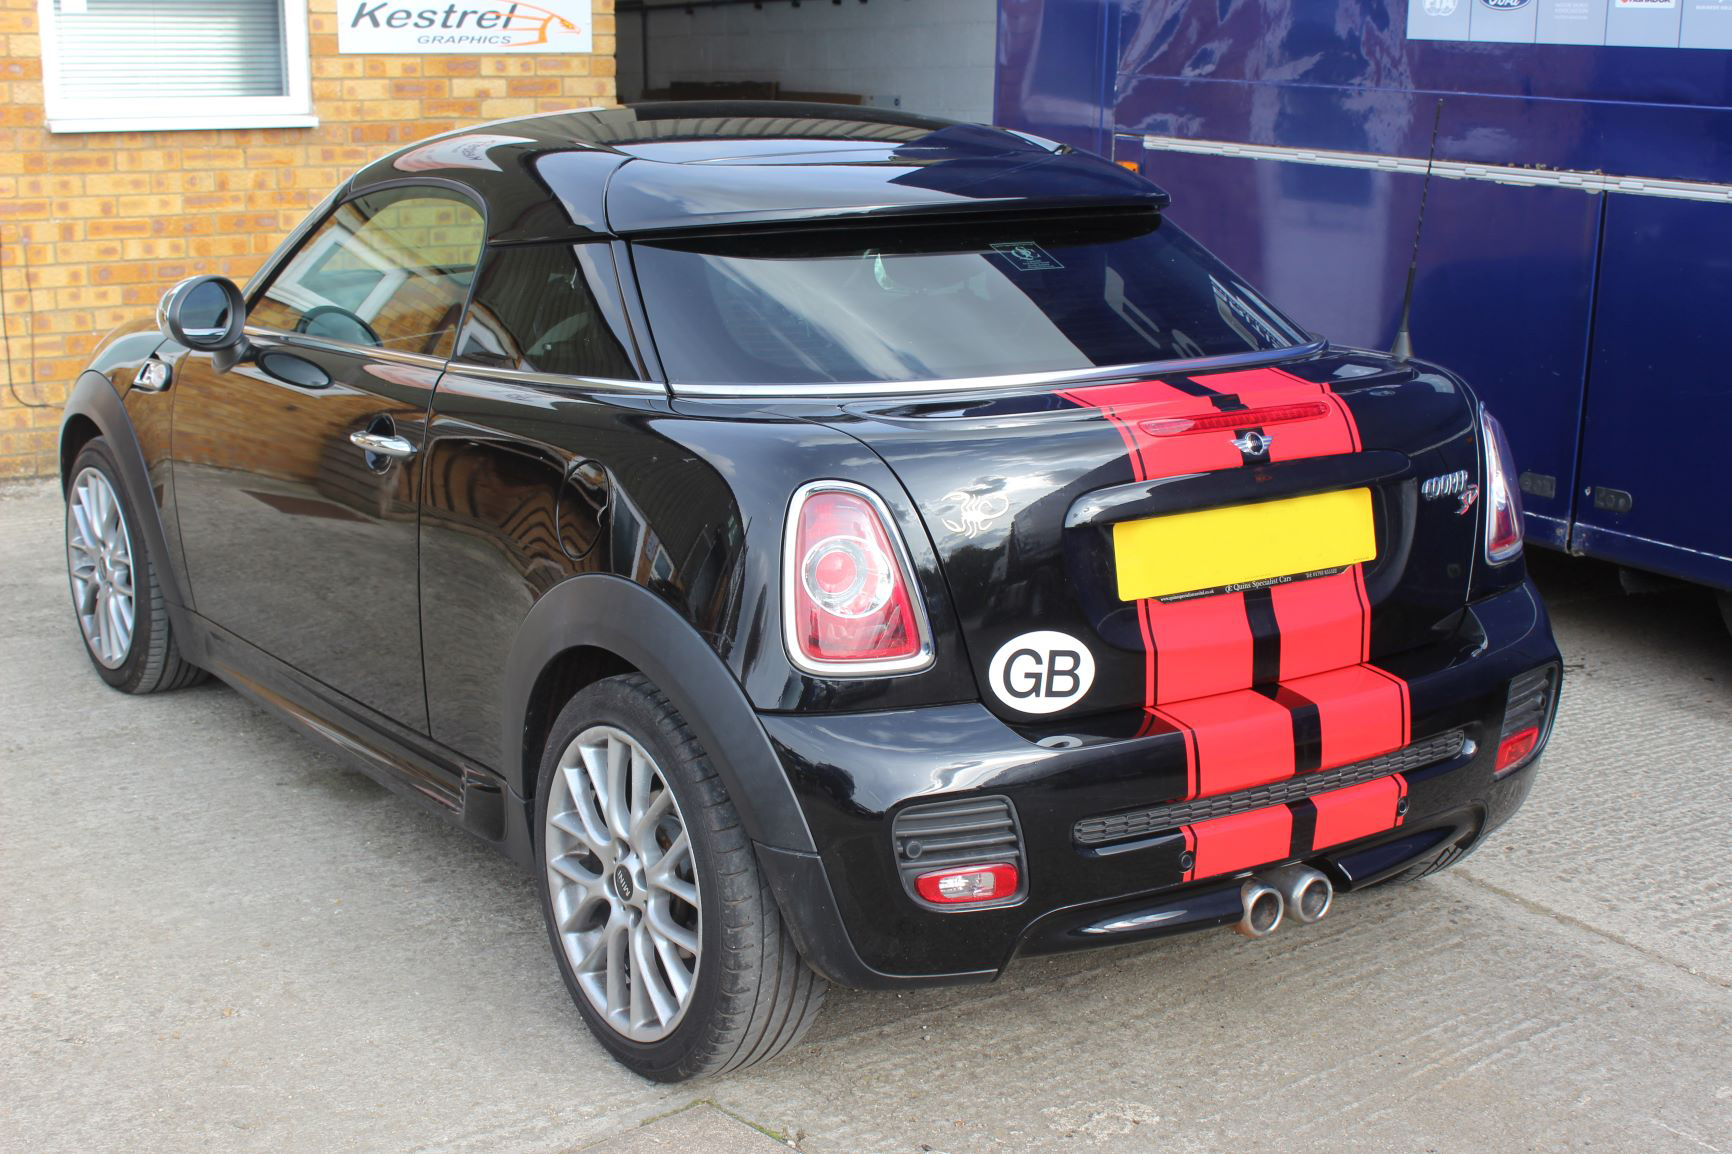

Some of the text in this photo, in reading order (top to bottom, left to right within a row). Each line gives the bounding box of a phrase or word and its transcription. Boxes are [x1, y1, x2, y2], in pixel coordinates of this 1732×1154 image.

[350, 2, 518, 29] Kestrel
[417, 35, 512, 44] GRAPHICS
[1252, 577, 1278, 588] Specialist
[1003, 648, 1081, 699] GB
[617, 870, 630, 896] MINI
